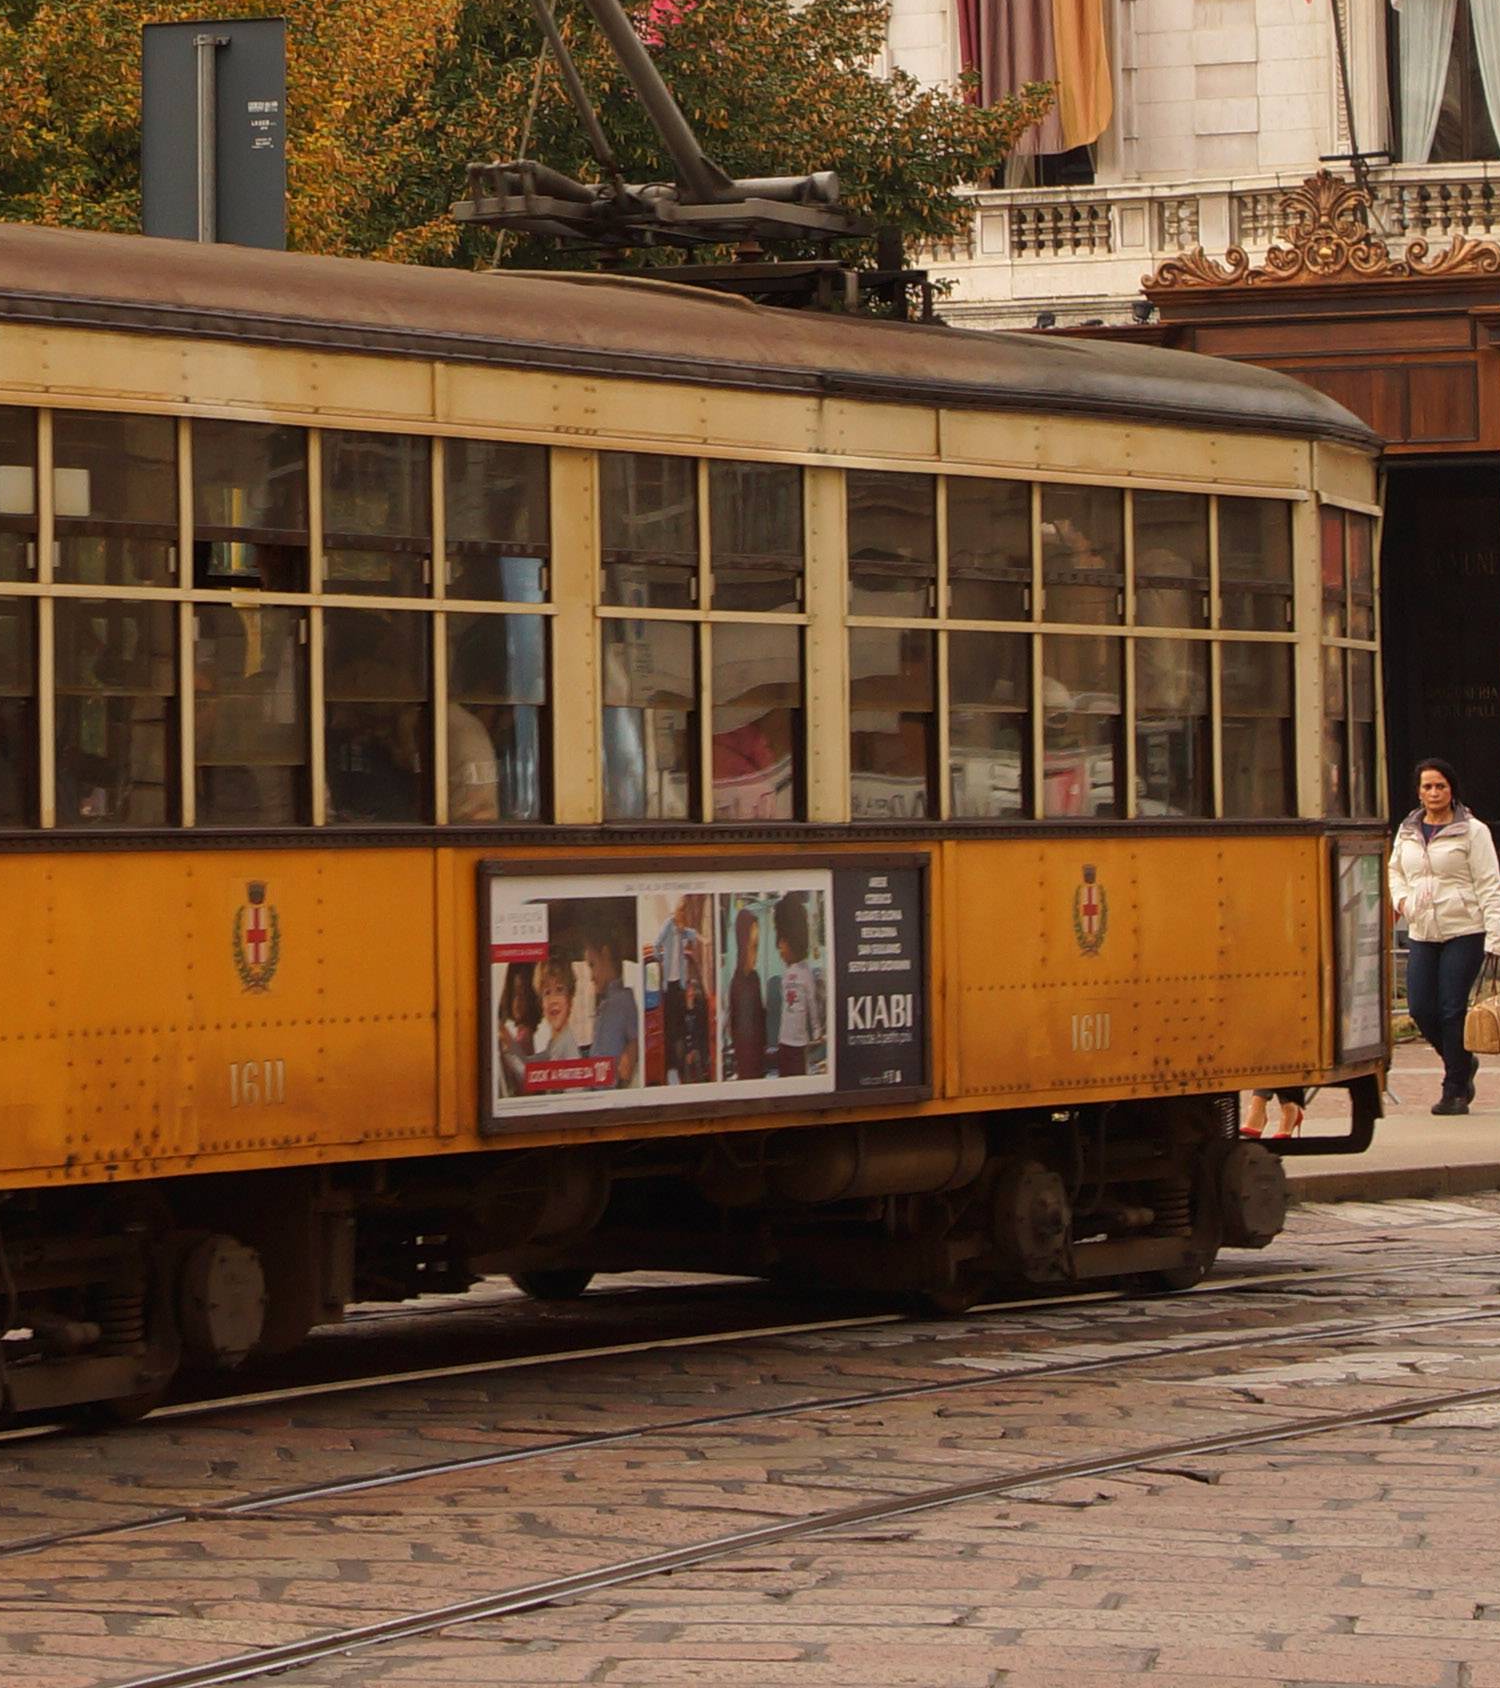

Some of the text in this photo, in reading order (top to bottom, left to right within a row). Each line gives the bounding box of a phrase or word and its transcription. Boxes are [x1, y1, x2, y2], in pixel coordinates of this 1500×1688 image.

[847, 994, 913, 1030] KIABI
[1071, 1013, 1111, 1052] 1611
[229, 1060, 285, 1108] 1611
